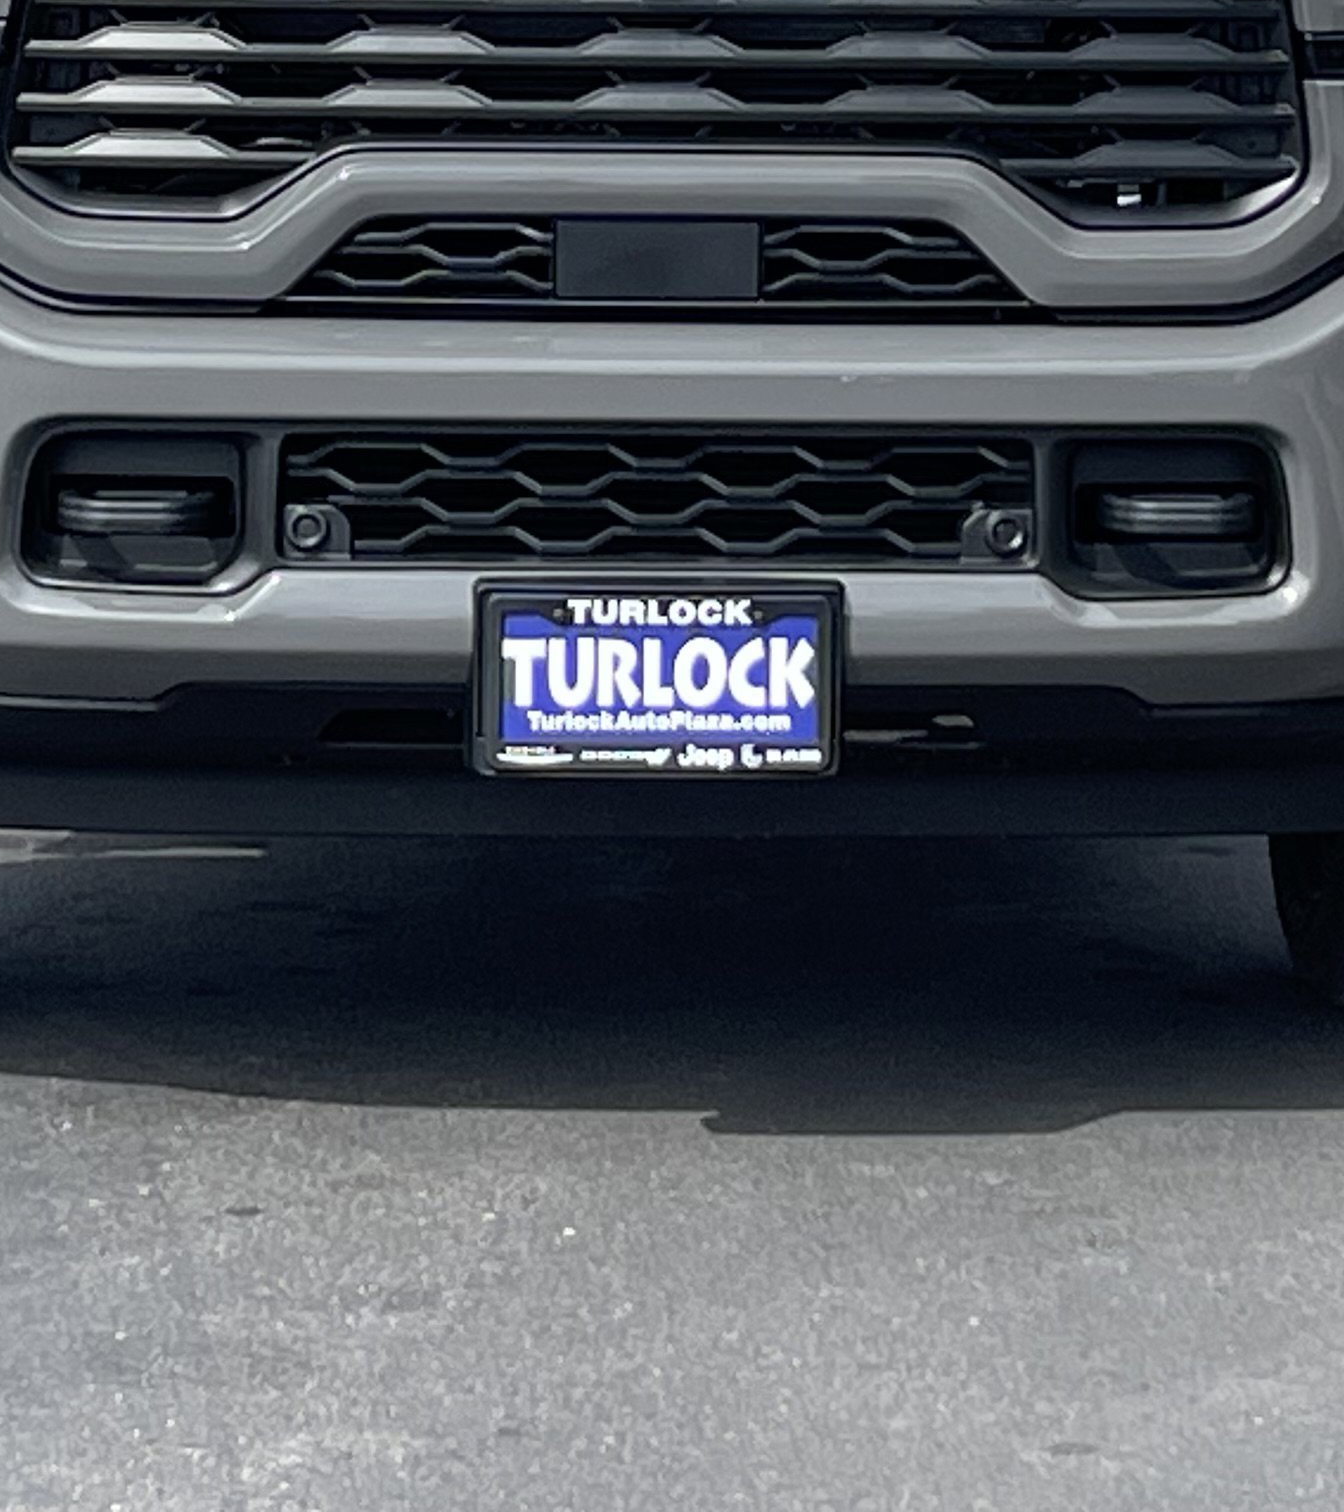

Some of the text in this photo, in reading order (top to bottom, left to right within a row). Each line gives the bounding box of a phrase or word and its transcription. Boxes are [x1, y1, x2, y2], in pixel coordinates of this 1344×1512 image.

[567, 598, 754, 626] TURLOCK
[501, 636, 816, 709] TURLOCK
[527, 709, 792, 732] TurlockAutoPlaza.com
